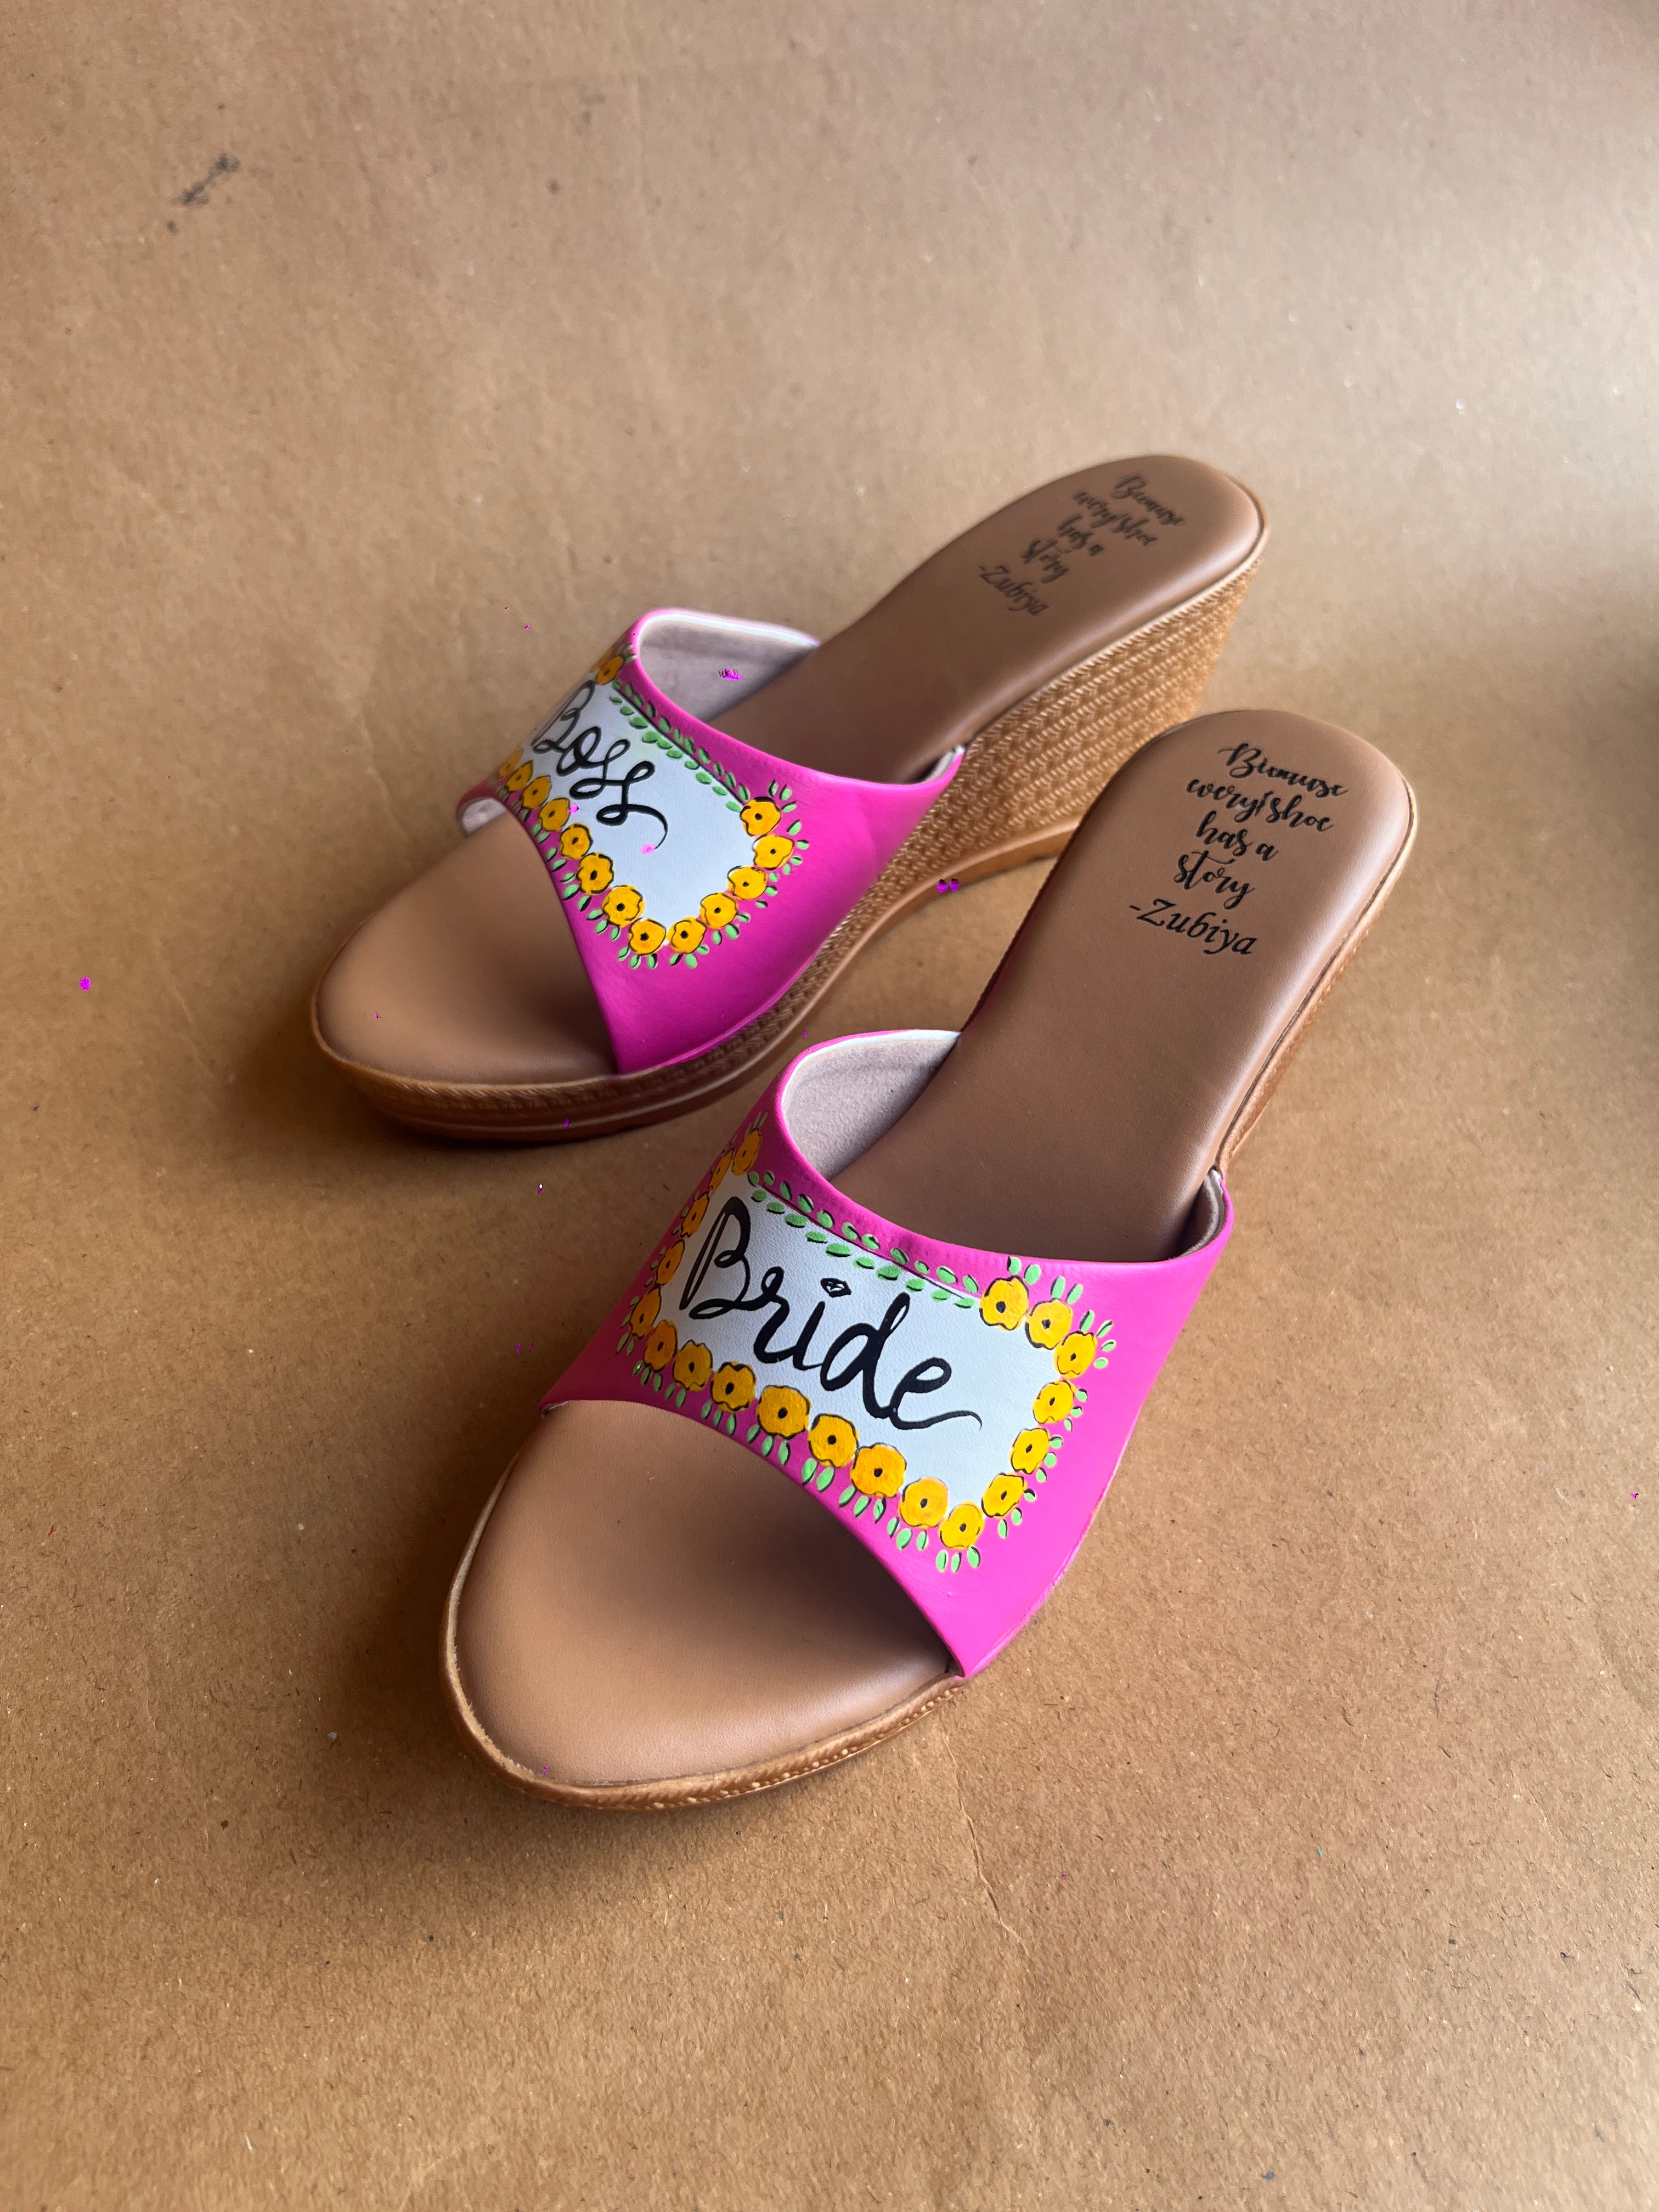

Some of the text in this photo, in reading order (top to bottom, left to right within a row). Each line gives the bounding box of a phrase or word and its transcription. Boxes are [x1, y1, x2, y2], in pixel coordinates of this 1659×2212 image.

[1196, 810, 1279, 861] has a
[1173, 850, 1255, 910] story
[680, 1196, 983, 1430] Bride
